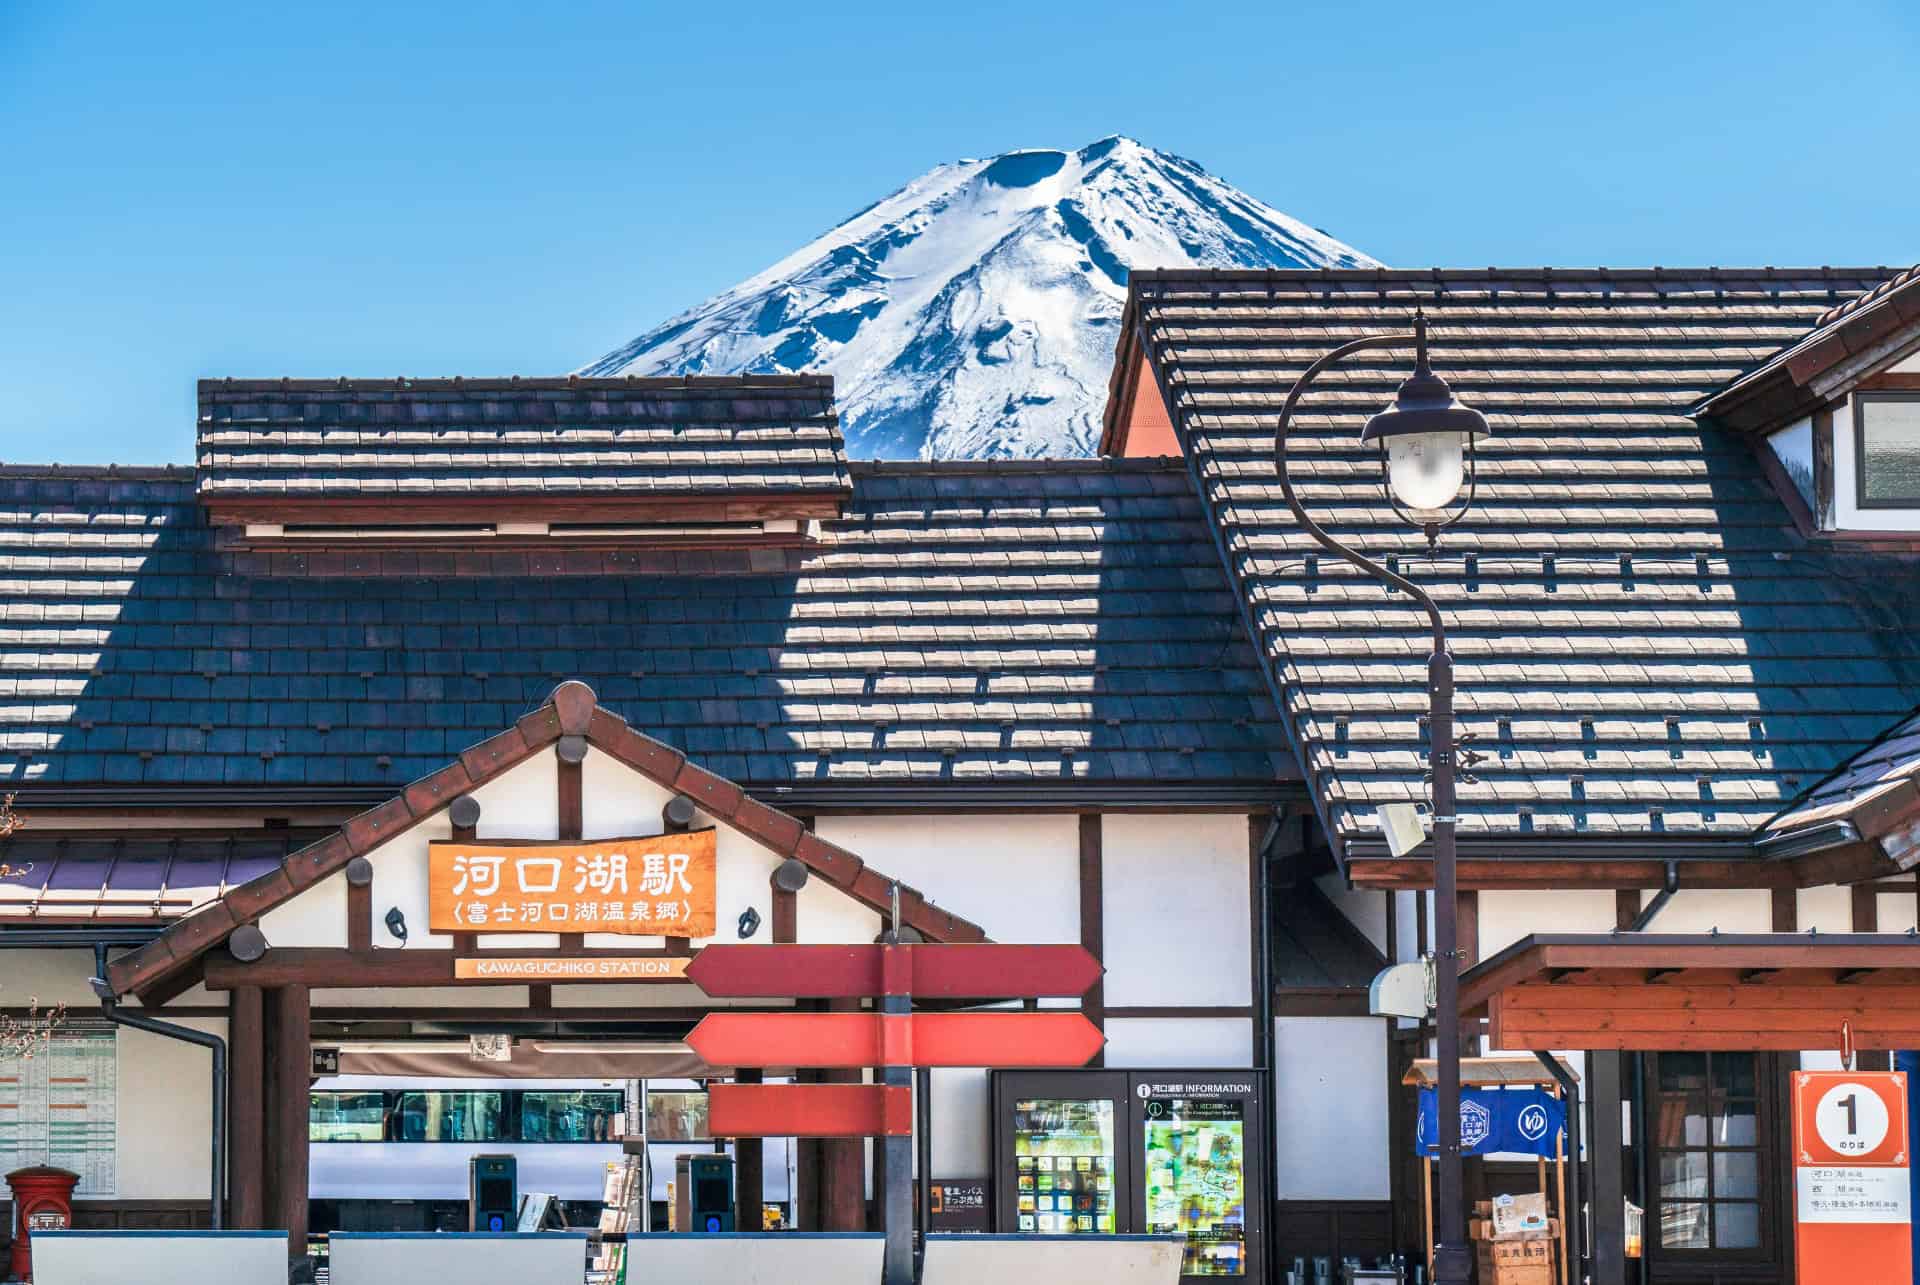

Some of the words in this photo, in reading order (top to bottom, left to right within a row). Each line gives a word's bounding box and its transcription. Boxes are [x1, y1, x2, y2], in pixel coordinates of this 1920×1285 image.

[452, 853, 693, 896] 河口湖駅
[477, 960, 596, 974] KAWAGUCHIKO
[599, 960, 671, 974] STATION
[1185, 1084, 1251, 1093] INFORMATION
[1524, 1111, 1545, 1135] ゆ
[1837, 1094, 1857, 1135] 1
[1839, 1141, 1865, 1149] のりば
